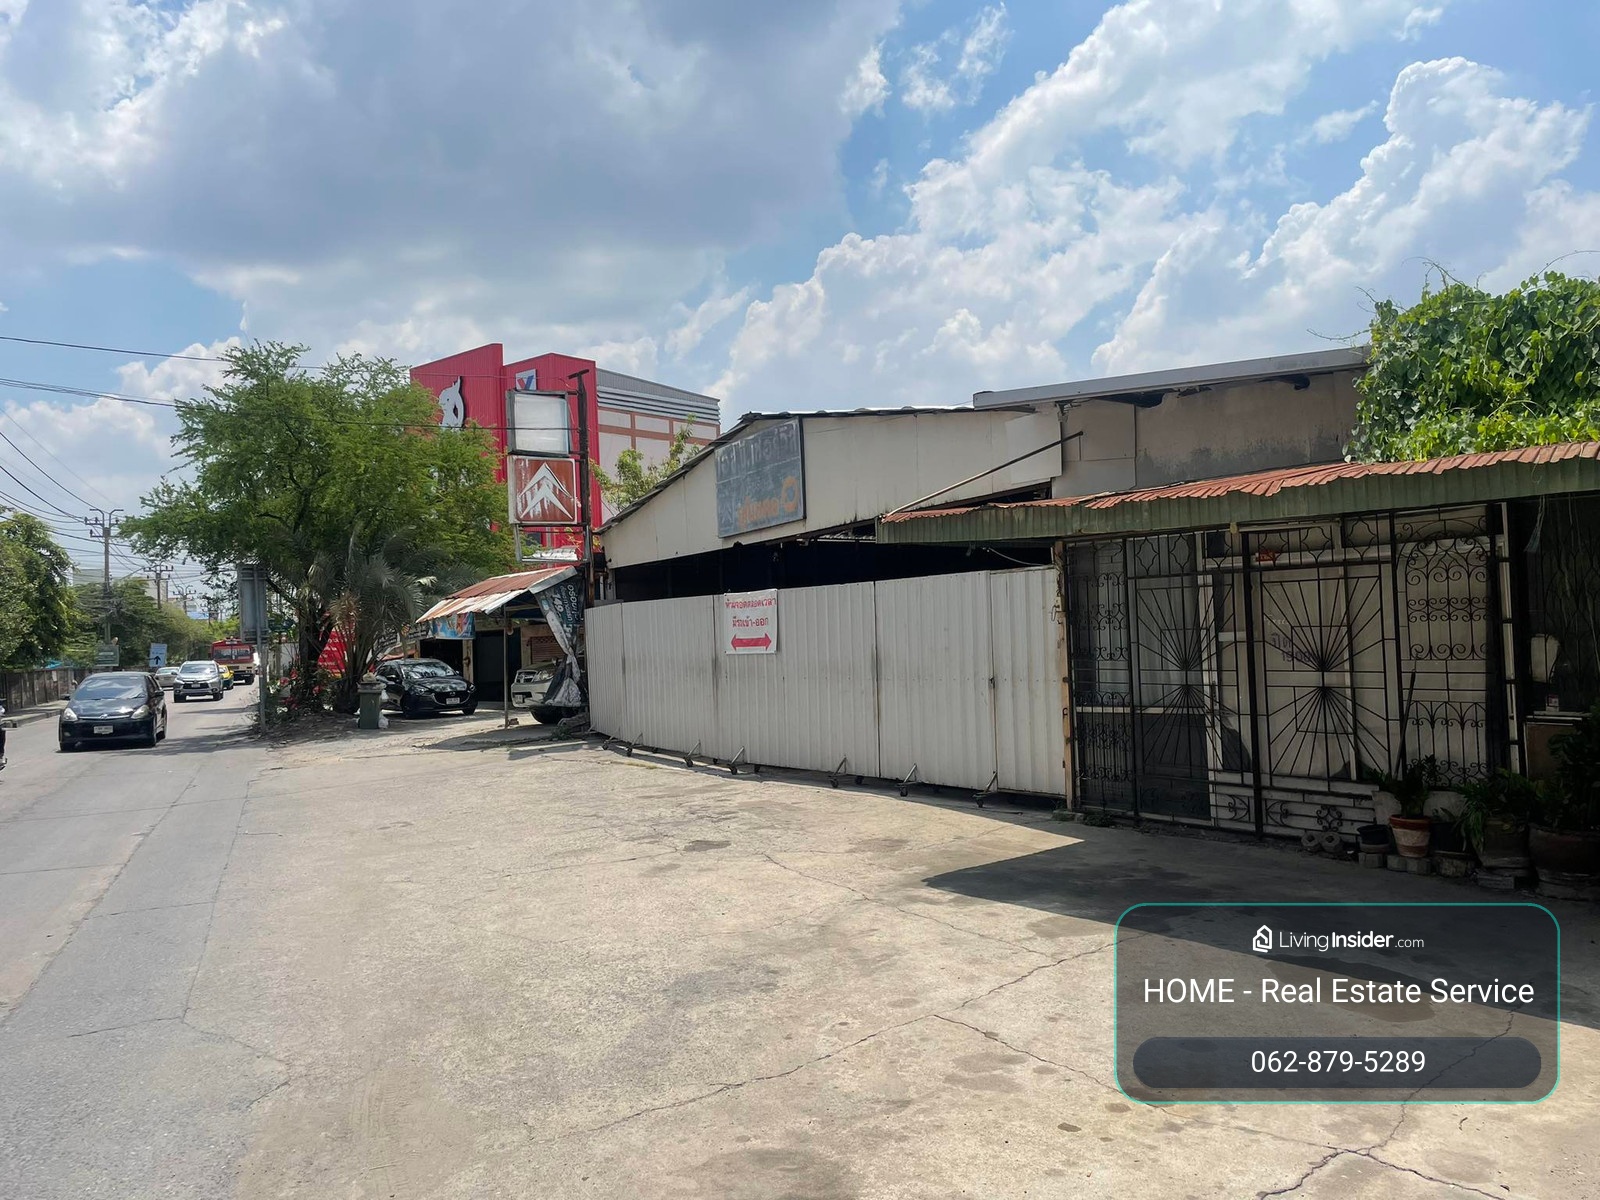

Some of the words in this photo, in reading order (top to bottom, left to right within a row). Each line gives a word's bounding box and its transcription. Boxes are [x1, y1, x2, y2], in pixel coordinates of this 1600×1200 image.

[725, 598, 776, 609] ห้ามจอดตลอดเวลา
[732, 615, 769, 628] มีรถเข้า-ออก
